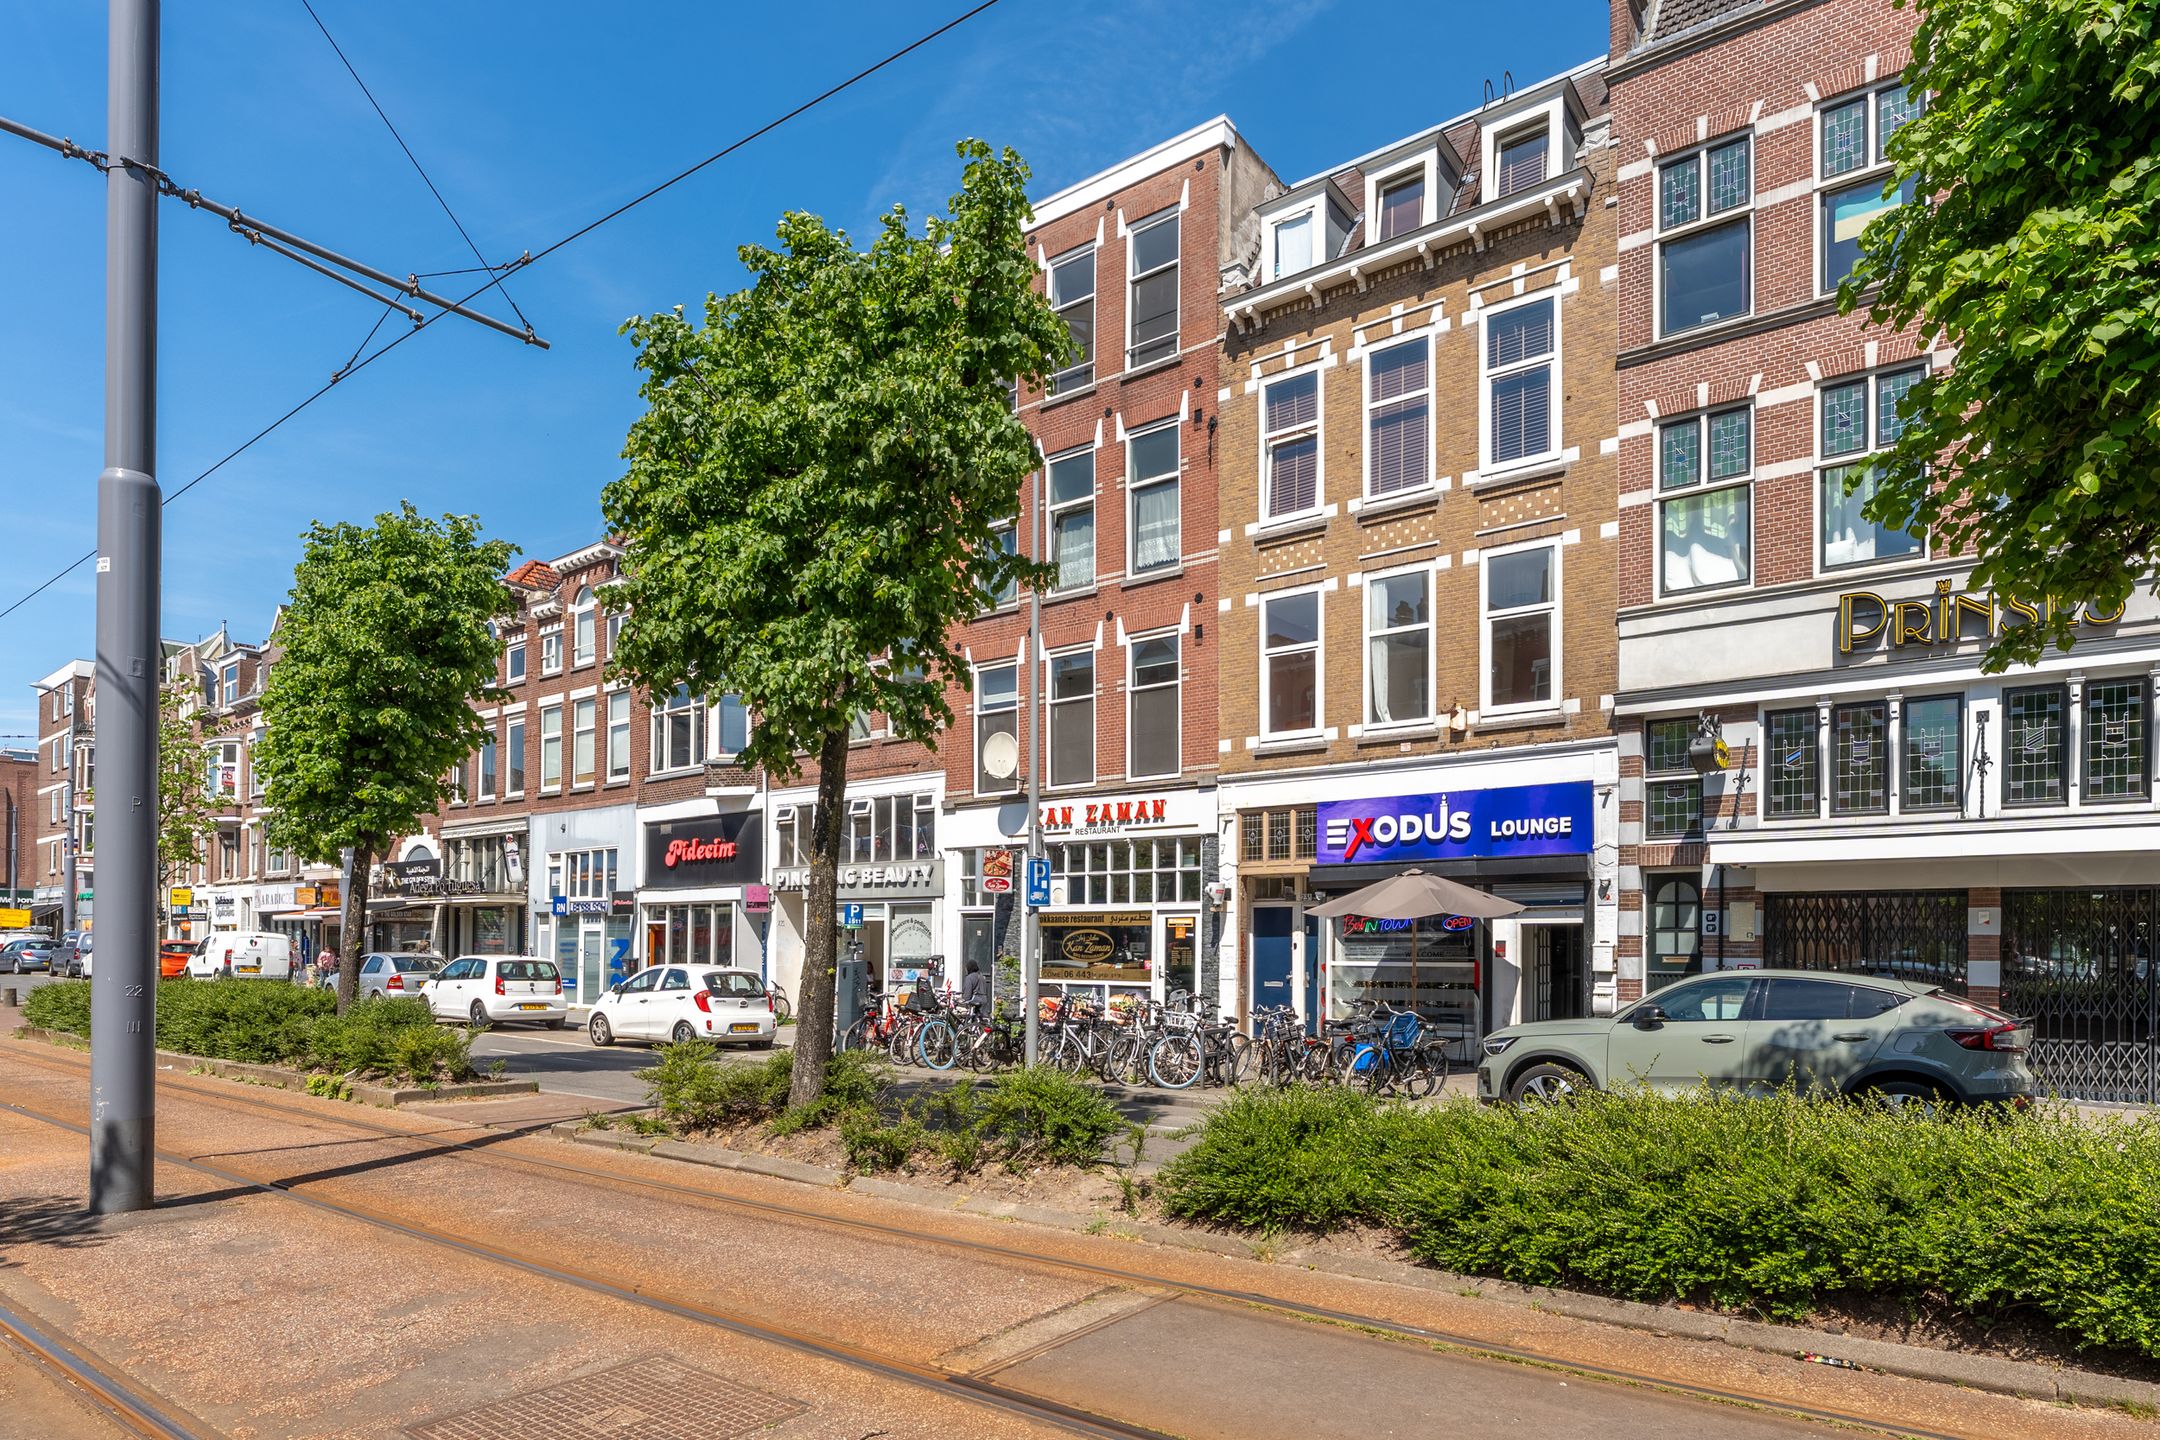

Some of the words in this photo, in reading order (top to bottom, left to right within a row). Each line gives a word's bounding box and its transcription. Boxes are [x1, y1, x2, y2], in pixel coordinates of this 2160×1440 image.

[1085, 799, 1166, 824] ZAMAN
[1075, 826, 1121, 836] RESTAURANT
[1327, 795, 1472, 859] EXODUS
[1491, 816, 1572, 837] LOUNGE
[665, 838, 736, 867] Pidecim
[861, 864, 931, 884] BEAUTY
[1034, 863, 1046, 886] P
[410, 882, 433, 896] Adega
[556, 903, 566, 913] RN
[851, 905, 860, 917] P
[1070, 914, 1105, 923] restaurant
[1445, 916, 1472, 929] OPEN
[1066, 941, 1083, 952] Kan
[1084, 941, 1111, 953] Zaman
[125, 984, 143, 997] 22
